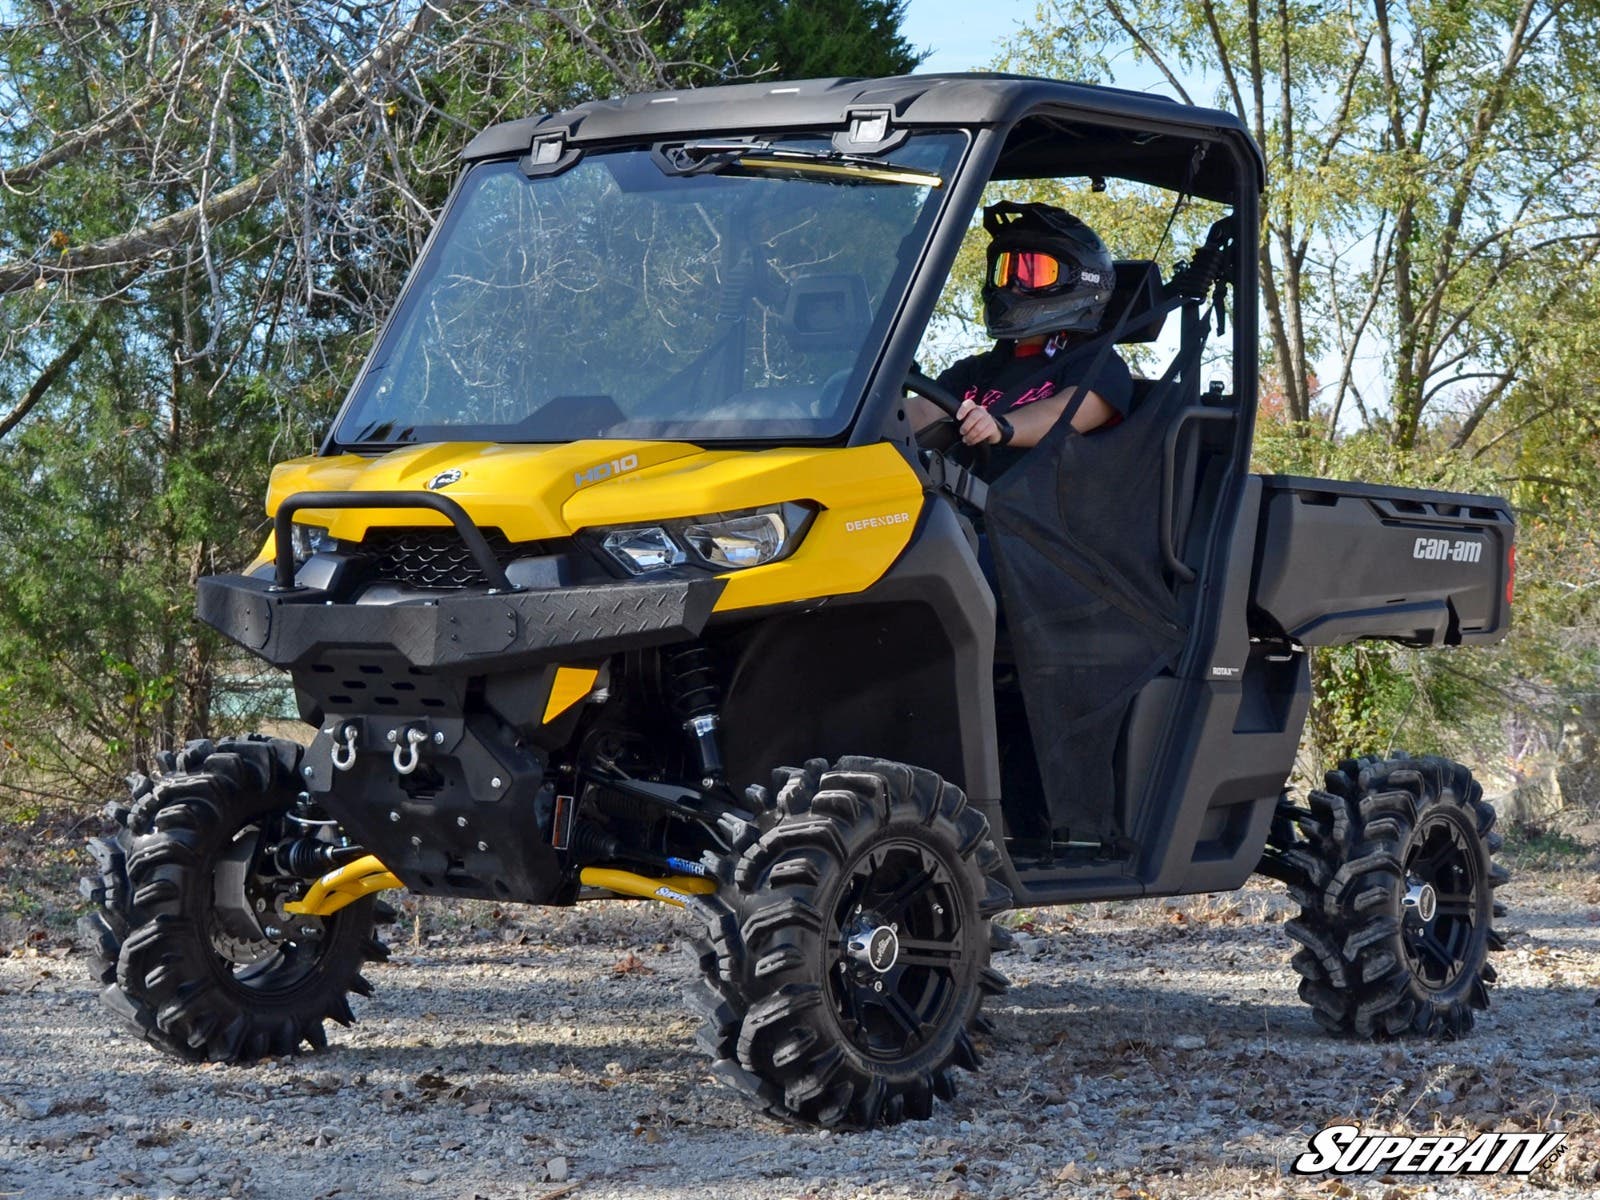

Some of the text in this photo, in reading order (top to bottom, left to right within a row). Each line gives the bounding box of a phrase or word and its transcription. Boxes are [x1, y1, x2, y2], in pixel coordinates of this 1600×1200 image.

[1081, 271, 1100, 283] 509
[575, 454, 638, 489] HD10
[845, 512, 909, 532] DEFENDER
